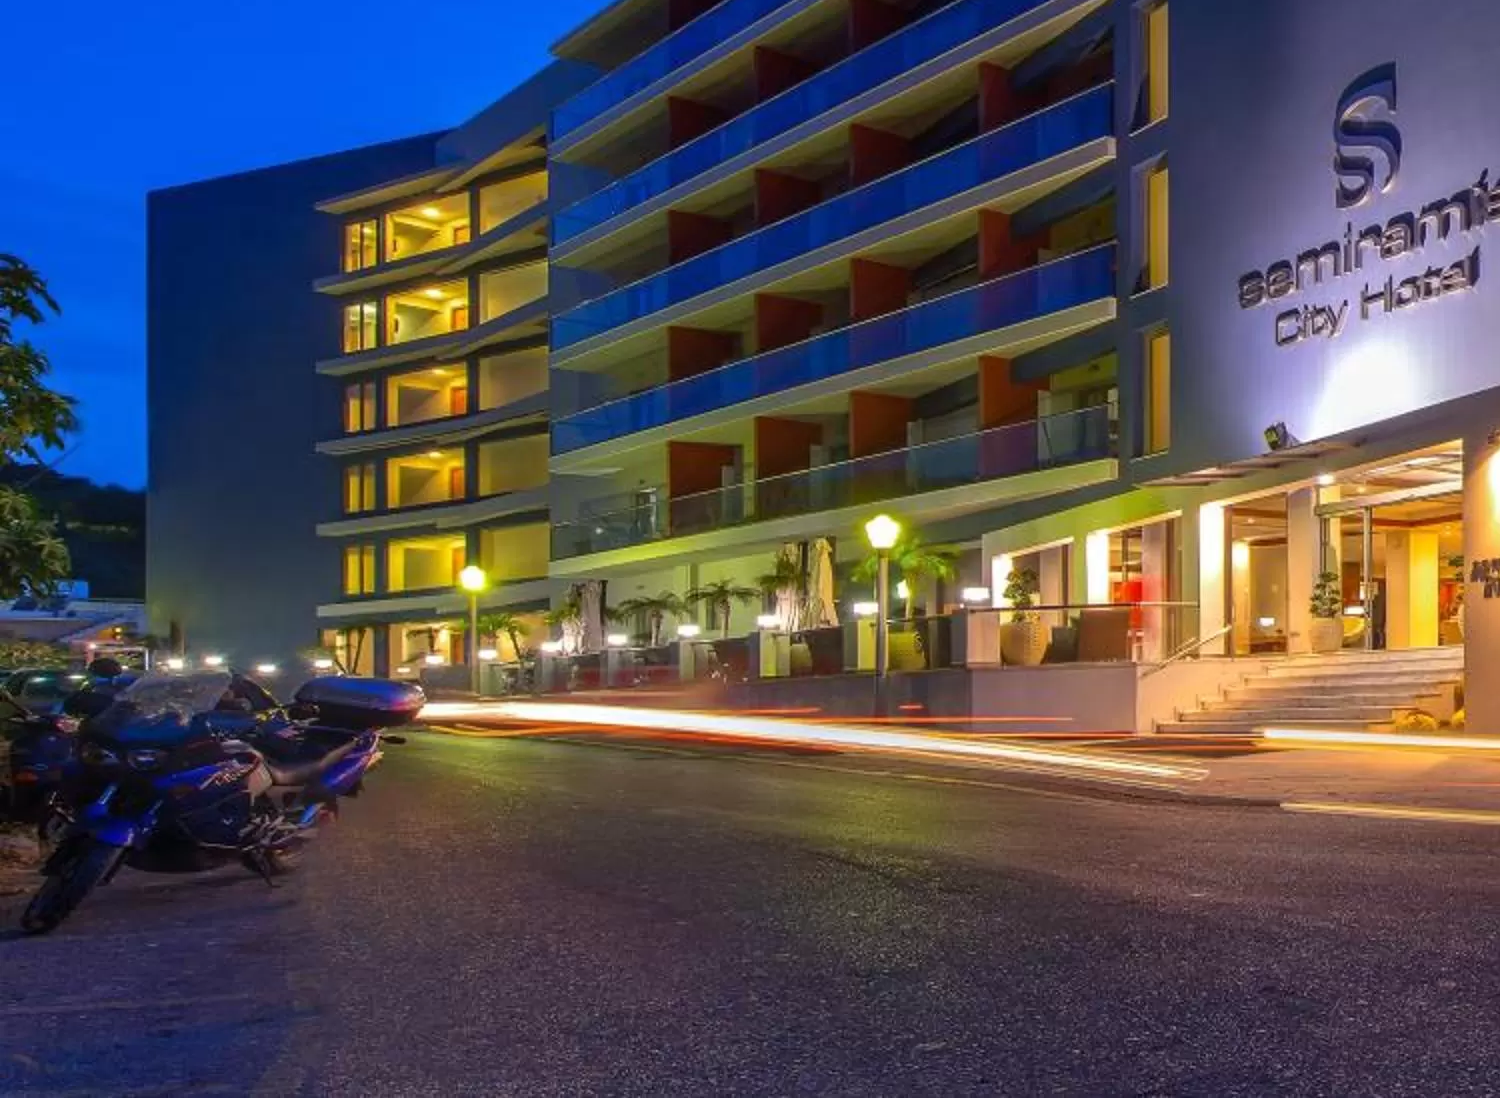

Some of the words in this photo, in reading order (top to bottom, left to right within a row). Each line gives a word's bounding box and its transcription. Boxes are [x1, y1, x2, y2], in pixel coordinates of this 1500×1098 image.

[1333, 60, 1402, 209] S
[1275, 298, 1349, 347] City
[1359, 244, 1482, 321] Hotel
